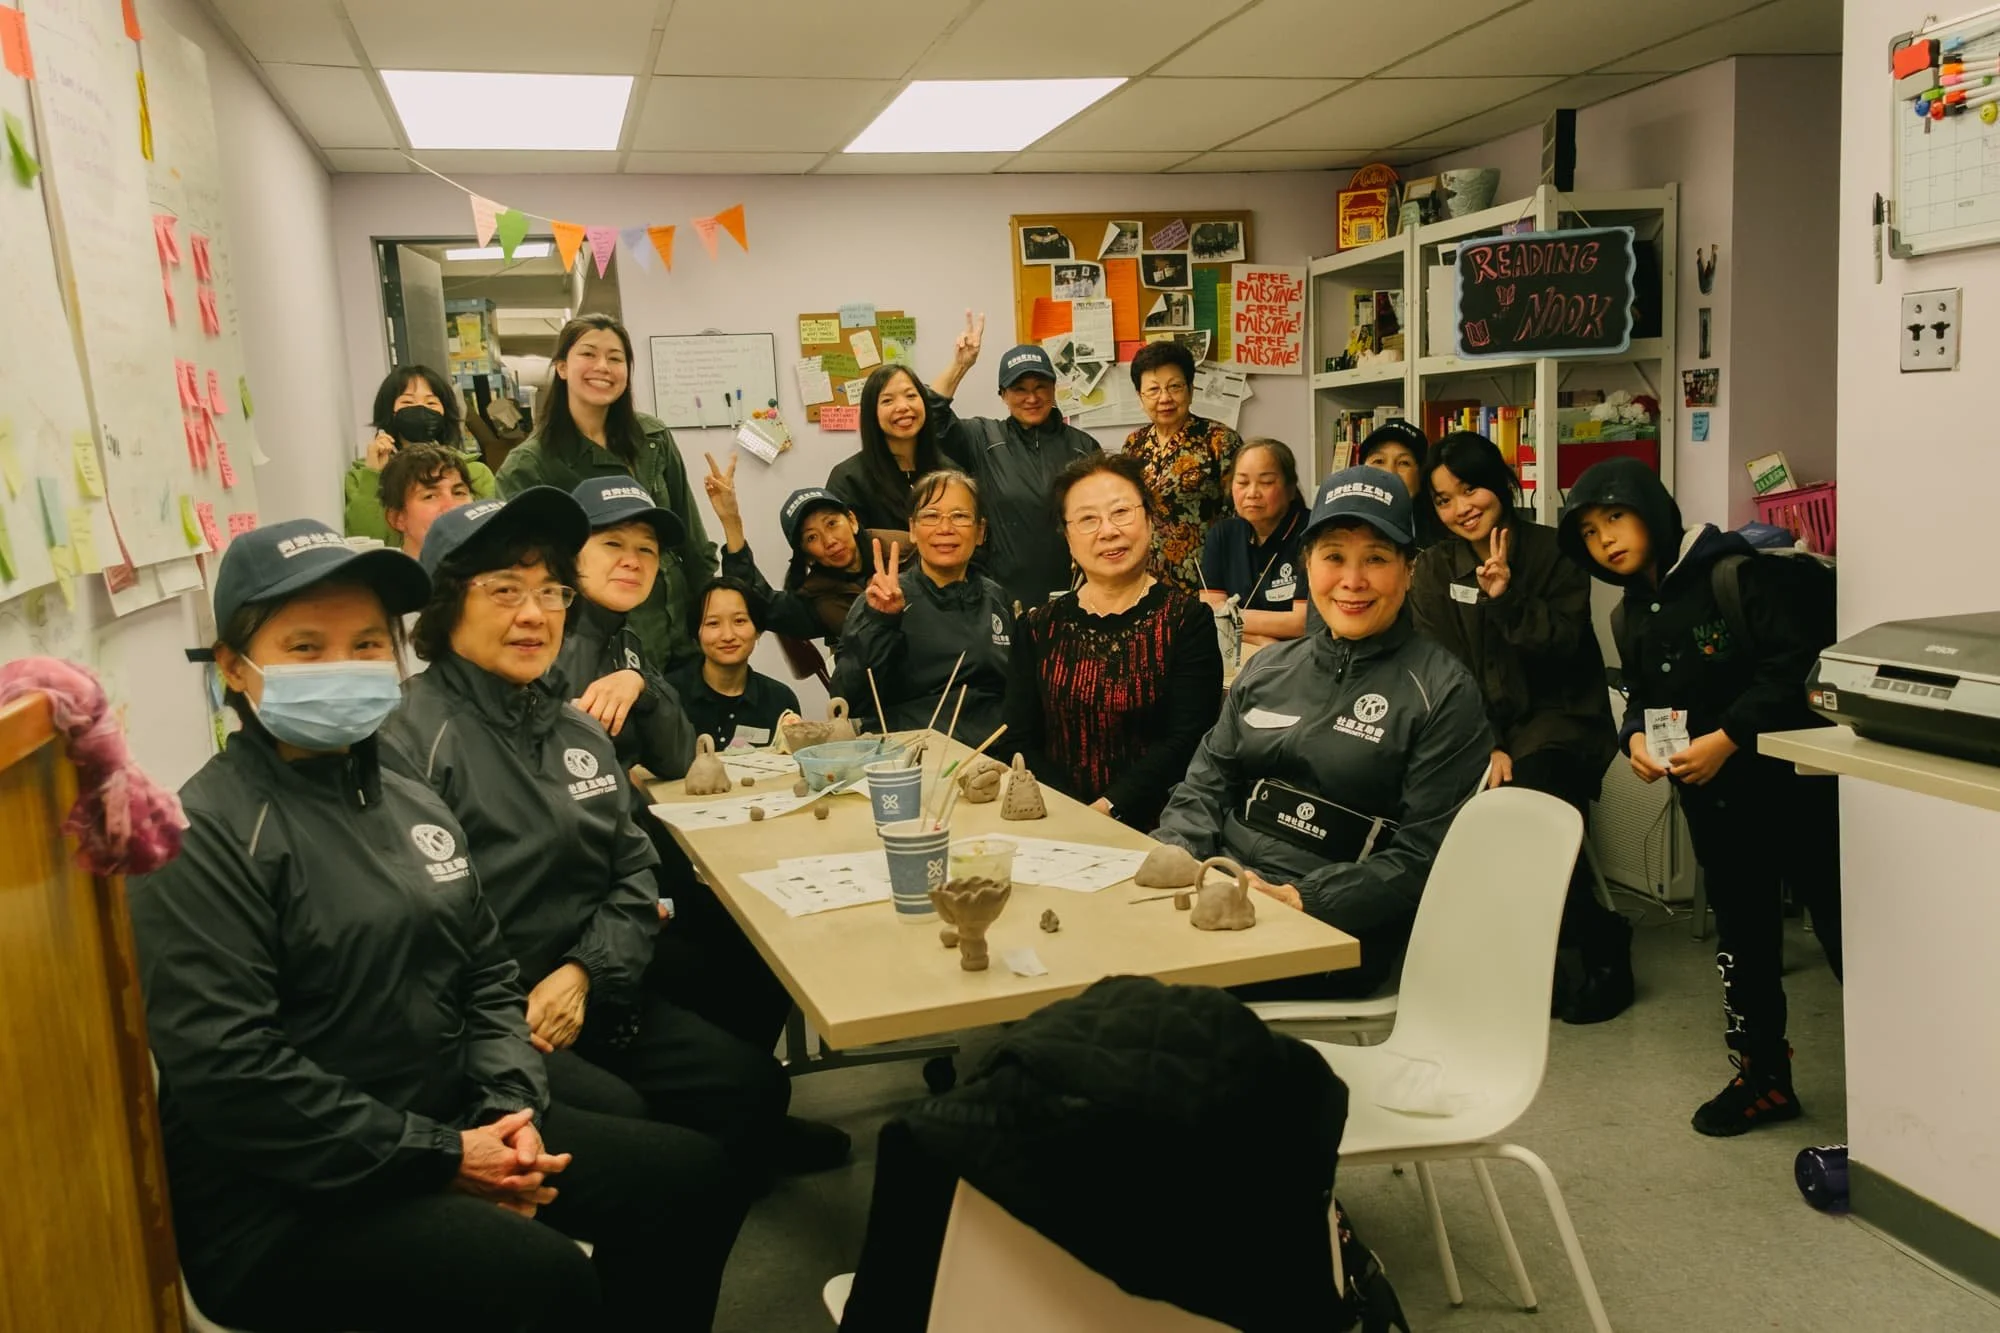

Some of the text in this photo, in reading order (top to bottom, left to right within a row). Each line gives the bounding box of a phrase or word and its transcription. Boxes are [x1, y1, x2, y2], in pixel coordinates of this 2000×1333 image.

[1466, 241, 1601, 284] READING
[1247, 273, 1293, 285] FREE
[1236, 280, 1303, 305] PALESTINE!
[1245, 304, 1291, 316] FREE
[1513, 285, 1613, 342] NOOK
[1235, 311, 1302, 336] PALESTINE!
[1245, 336, 1289, 347] FREE
[1235, 343, 1300, 367] PALESTINE!
